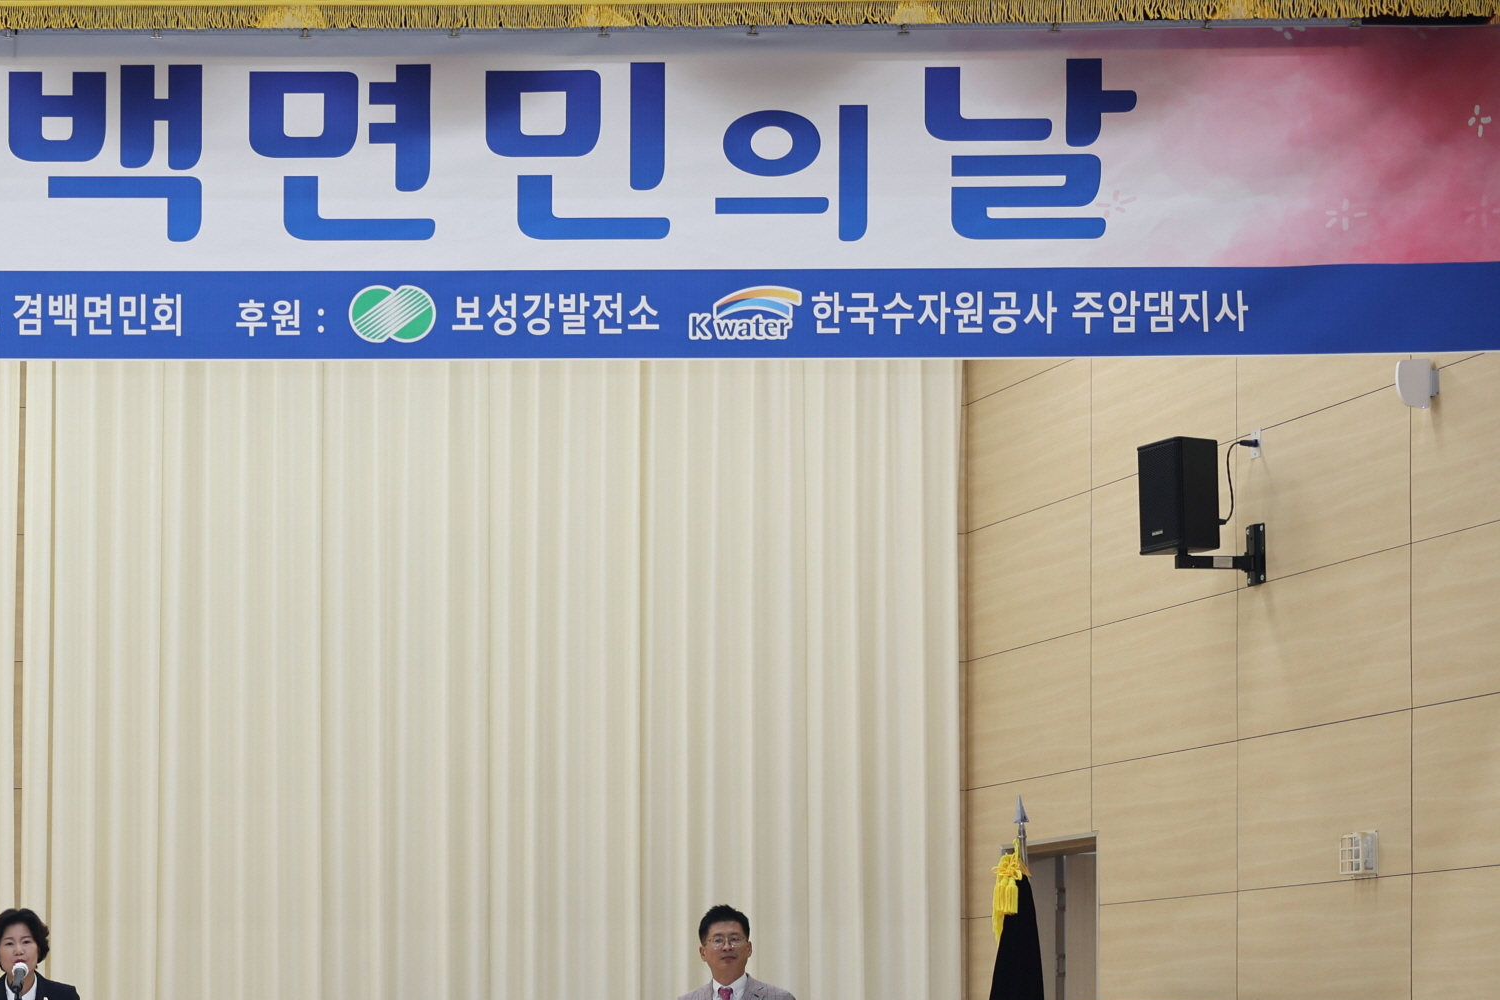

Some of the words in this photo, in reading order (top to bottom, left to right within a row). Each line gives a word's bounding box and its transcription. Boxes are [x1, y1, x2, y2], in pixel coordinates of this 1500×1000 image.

[12, 293, 182, 337] 겸백면민회
[235, 298, 301, 337] 후원
[451, 292, 660, 336] 보성강발전소
[811, 290, 1058, 335] 한국수자원공사
[1071, 290, 1249, 334] 주암댐지사
